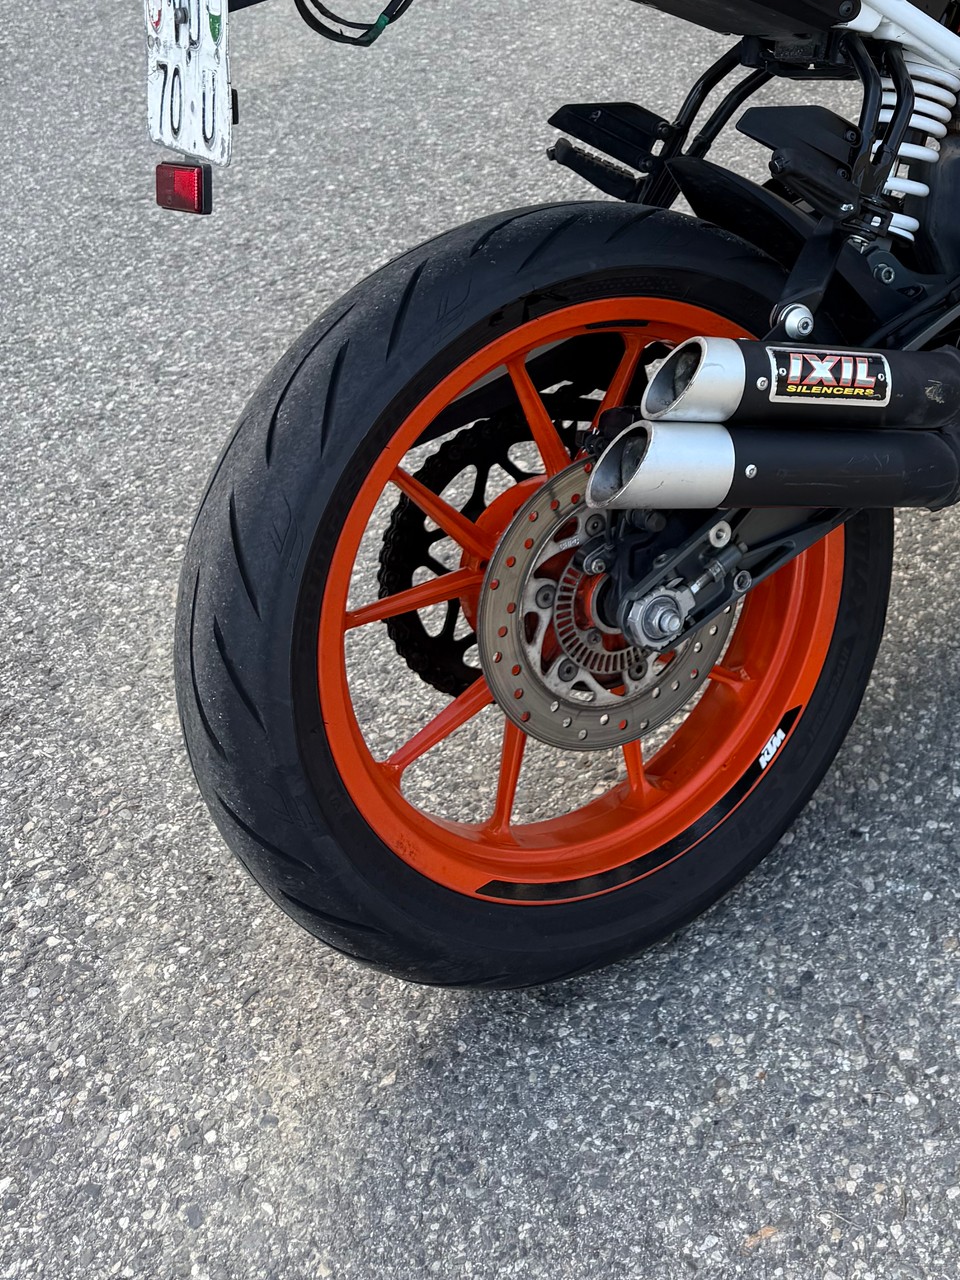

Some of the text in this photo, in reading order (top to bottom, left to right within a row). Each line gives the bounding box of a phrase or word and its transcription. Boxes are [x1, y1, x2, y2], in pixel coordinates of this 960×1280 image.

[786, 352, 877, 388] IXIL
[785, 384, 876, 397] SILENCERS
[758, 728, 787, 770] KTM
